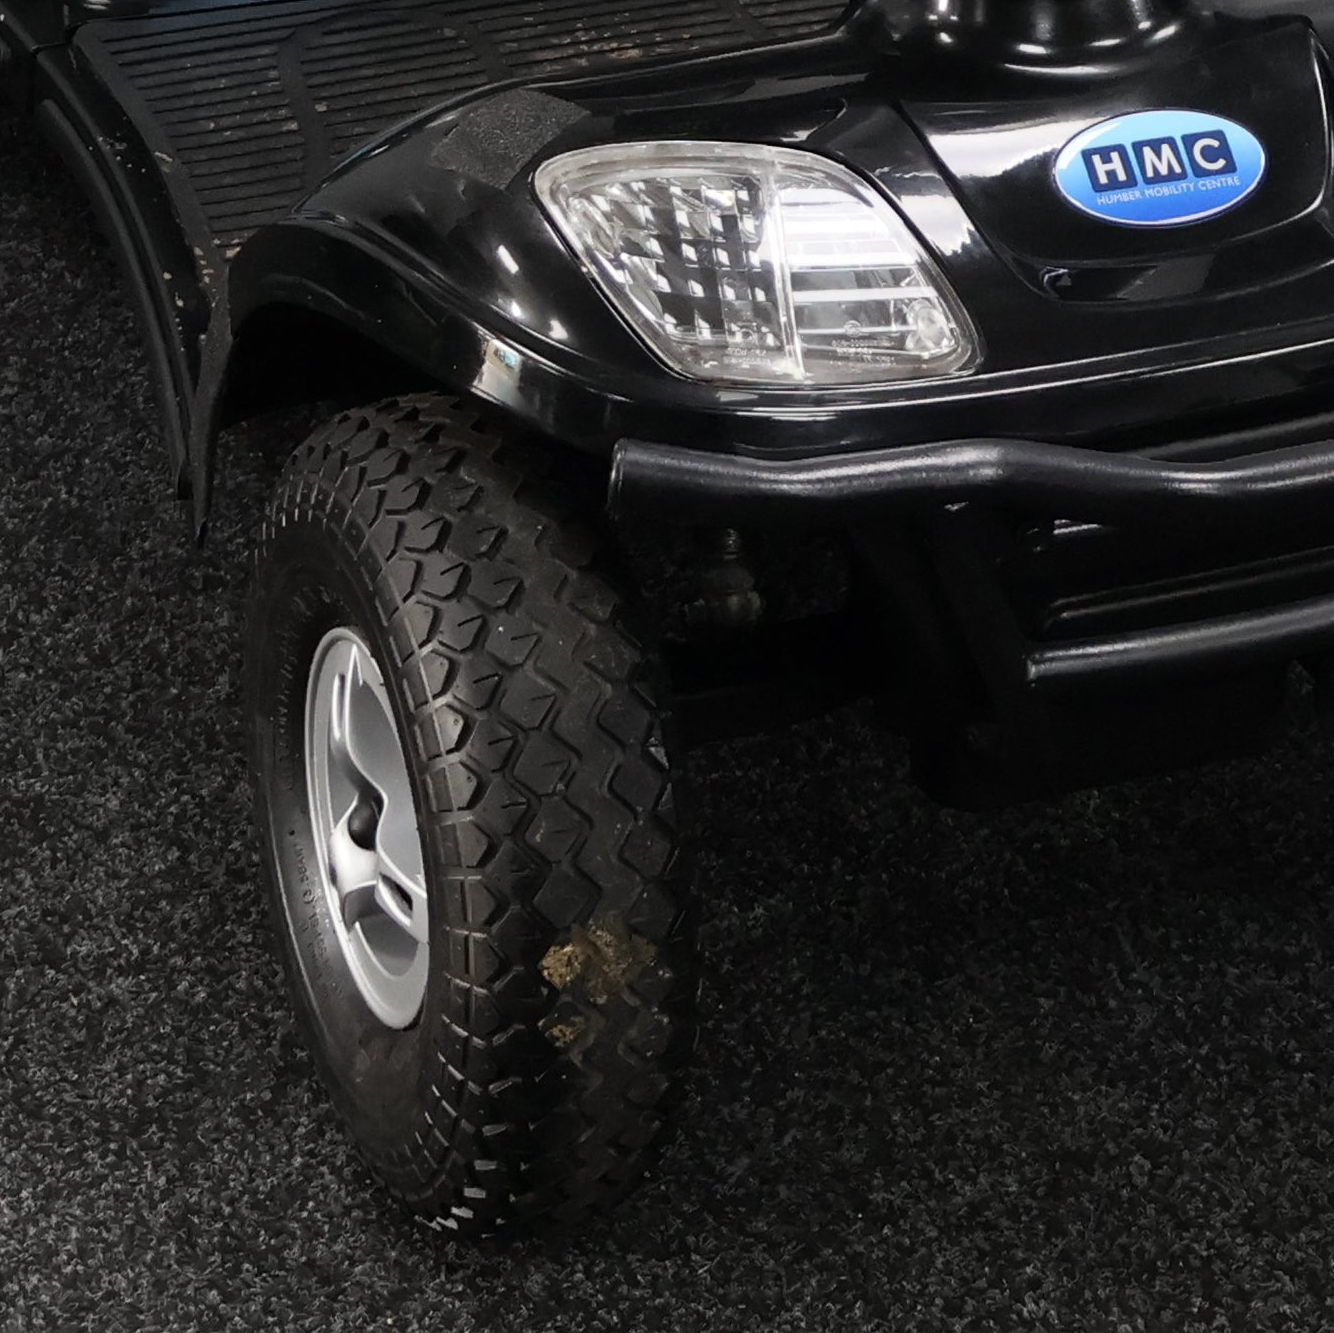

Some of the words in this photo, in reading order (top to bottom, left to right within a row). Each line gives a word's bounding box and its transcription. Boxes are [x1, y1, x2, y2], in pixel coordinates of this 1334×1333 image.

[1091, 137, 1227, 185] HMC
[1096, 190, 1142, 206] HUMBER
[1144, 182, 1196, 200] MOBILITY
[1199, 176, 1241, 192] CENTRE
